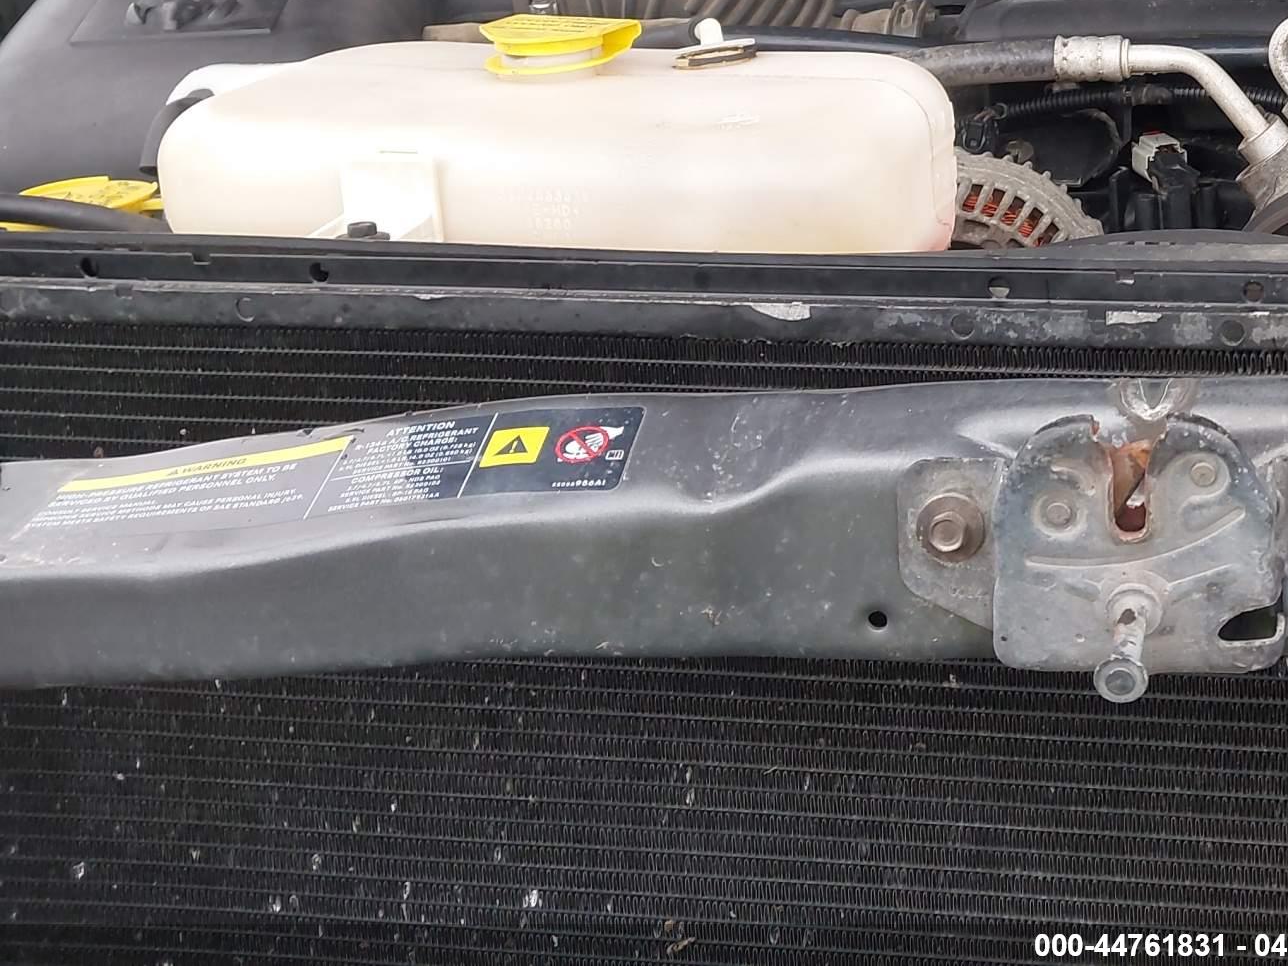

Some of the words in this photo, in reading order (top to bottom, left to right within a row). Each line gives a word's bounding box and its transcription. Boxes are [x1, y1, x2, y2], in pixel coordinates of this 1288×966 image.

[385, 421, 456, 437] ATTENTION
[409, 427, 479, 442] REFRIGERANT
[366, 442, 412, 455] FACTORY
[182, 458, 247, 473] WARNING
[145, 474, 221, 491] REFRIGERANT
[219, 468, 265, 480] SYSTEM
[266, 465, 281, 474] TO
[281, 462, 298, 472] BE
[351, 468, 422, 484] COMPRESSOR
[422, 466, 445, 475] OIL:
[120, 486, 177, 501] QUALIFIED
[177, 478, 242, 492] PERSONNEL
[245, 474, 277, 484] ONLY.
[214, 493, 262, 504] PERSONAL
[232, 497, 281, 509] STANDARD
